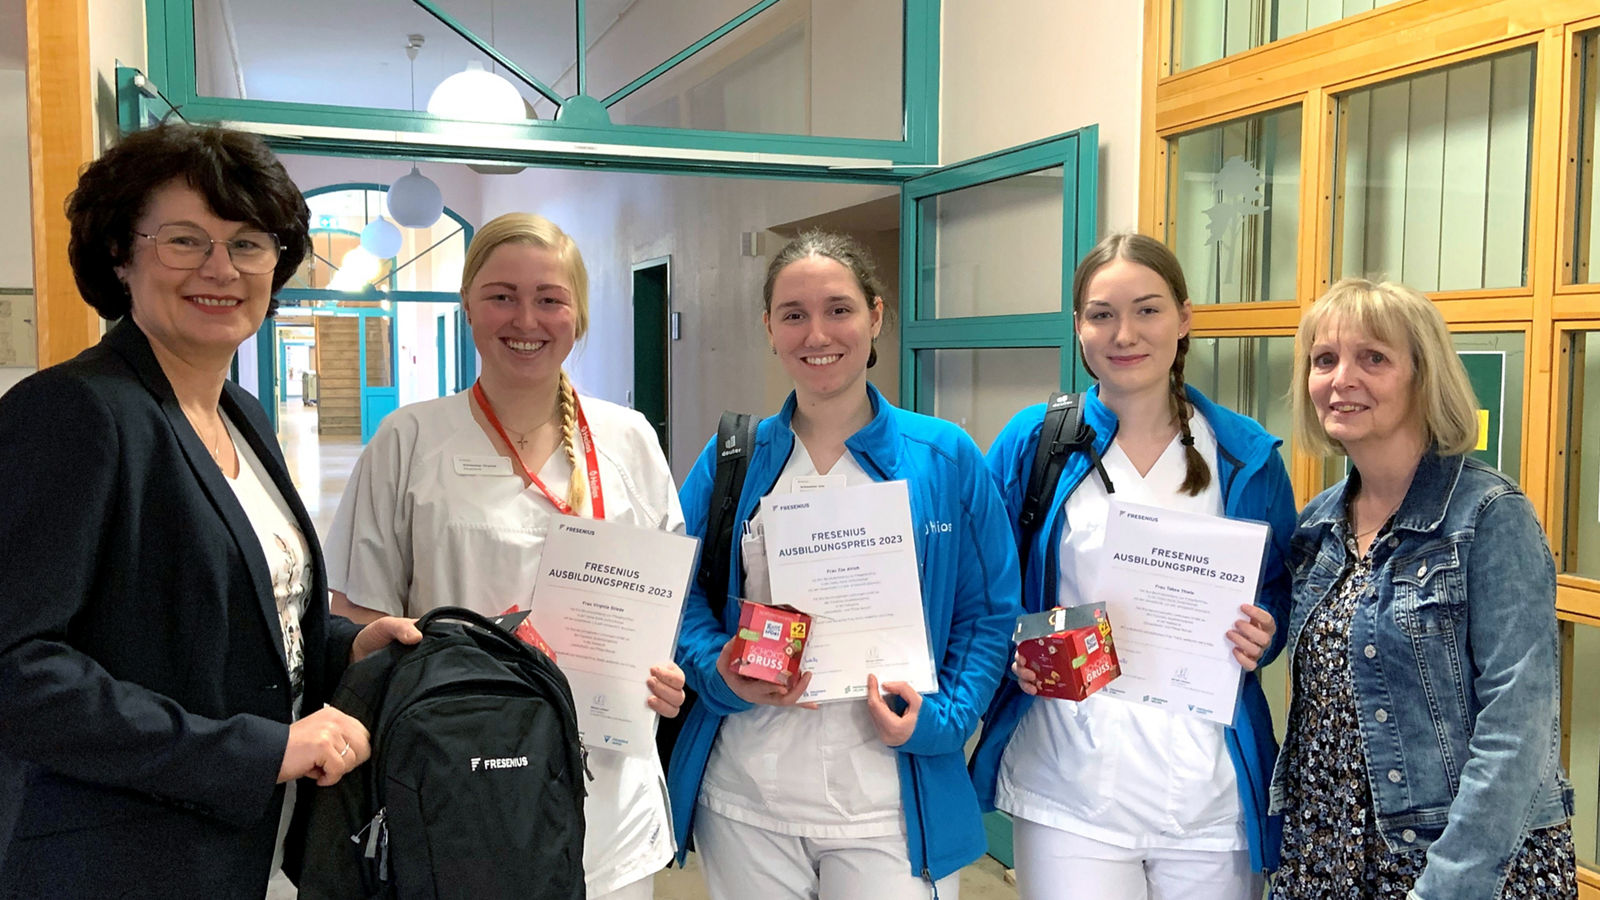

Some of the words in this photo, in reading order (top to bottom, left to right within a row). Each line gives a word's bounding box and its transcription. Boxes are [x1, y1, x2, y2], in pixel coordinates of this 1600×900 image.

[780, 503, 810, 511] FRESENIUS
[1127, 513, 1158, 522] FRESENIUS
[566, 526, 595, 535] FRESENIUS
[811, 527, 866, 541] FRESENIUS
[779, 538, 876, 557] AUSBILDUNGSPREIS
[879, 535, 903, 545] 2023
[1151, 547, 1209, 565] FRESENIUS
[584, 561, 640, 579] FRESENIUS
[1113, 552, 1216, 578] AUSBILDUNGSPREIS
[1219, 571, 1245, 584] 2023
[548, 568, 646, 593] AUSBILDUNGSPREIS
[648, 586, 673, 599] 2023
[747, 653, 783, 670] GRUSS
[1087, 661, 1110, 682] GRUSS
[484, 756, 528, 770] FRESENIUS
